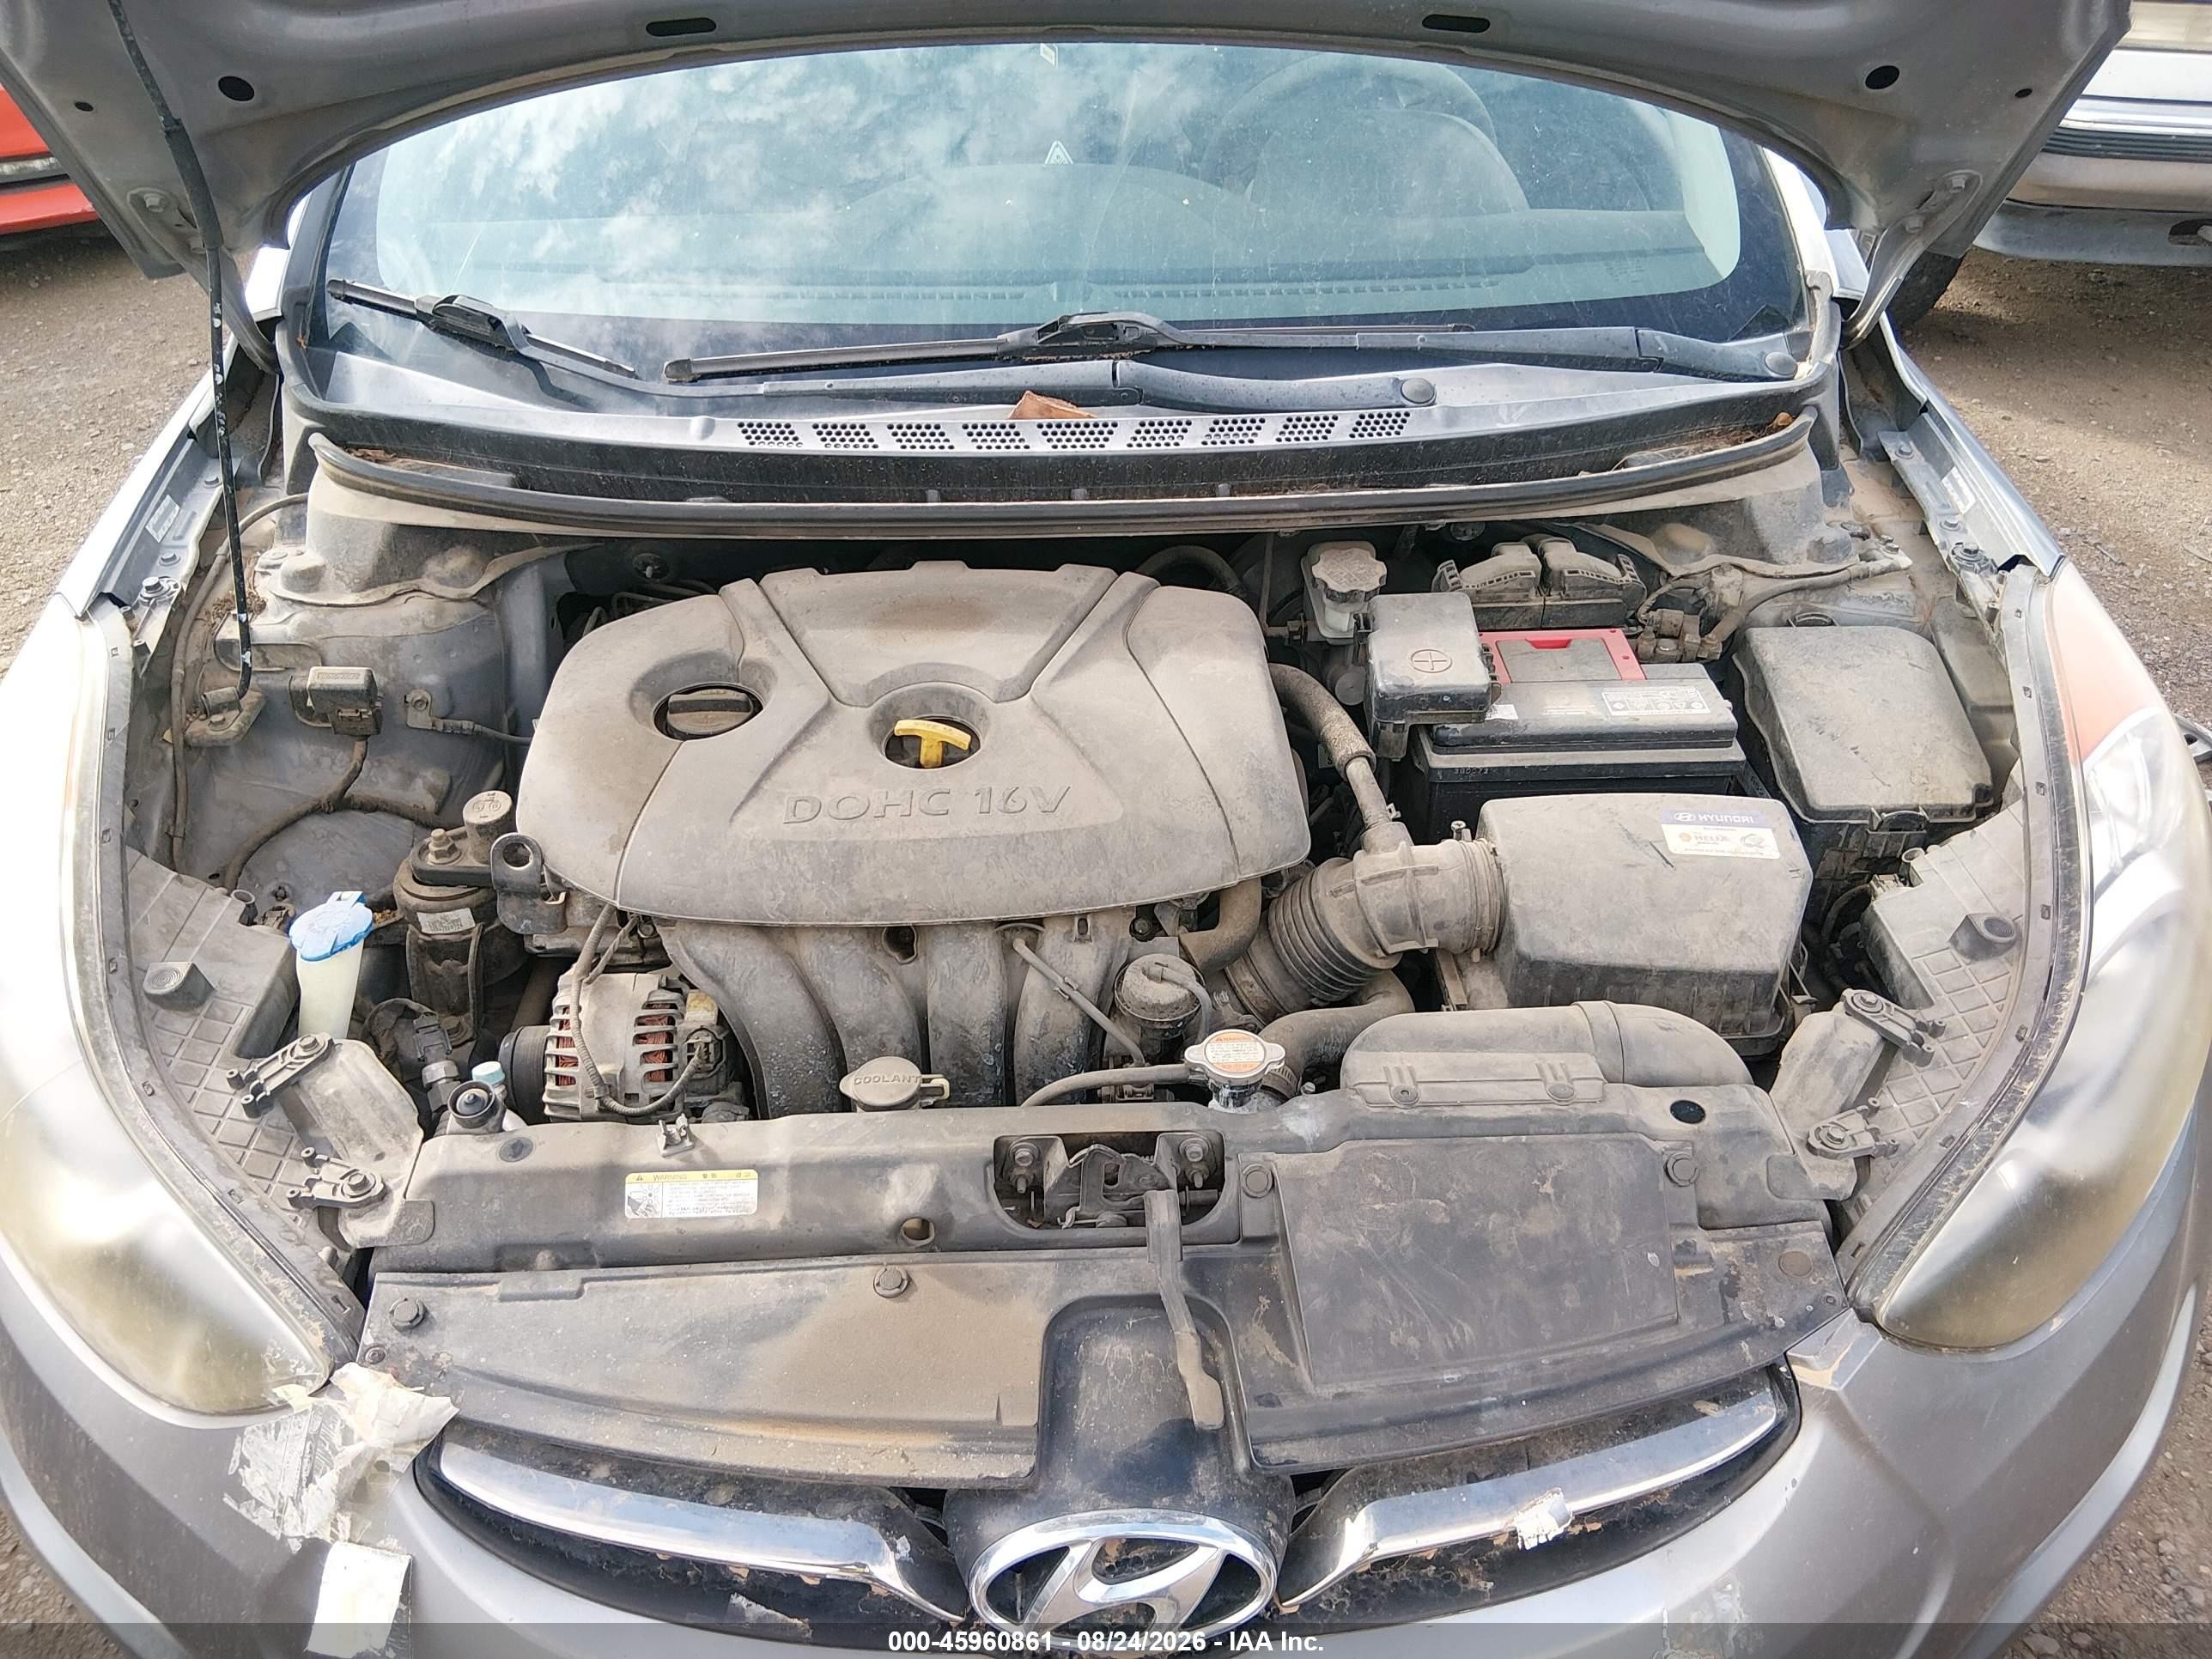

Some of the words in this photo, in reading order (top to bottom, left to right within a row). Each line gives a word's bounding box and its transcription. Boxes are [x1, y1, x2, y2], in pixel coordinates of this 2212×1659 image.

[783, 788, 951, 824] DOHC
[974, 786, 1071, 815] 16V
[1698, 813, 1754, 824] HYUNDAI
[854, 1073, 921, 1085] COOLANT
[653, 1173, 688, 1182] WARNING
